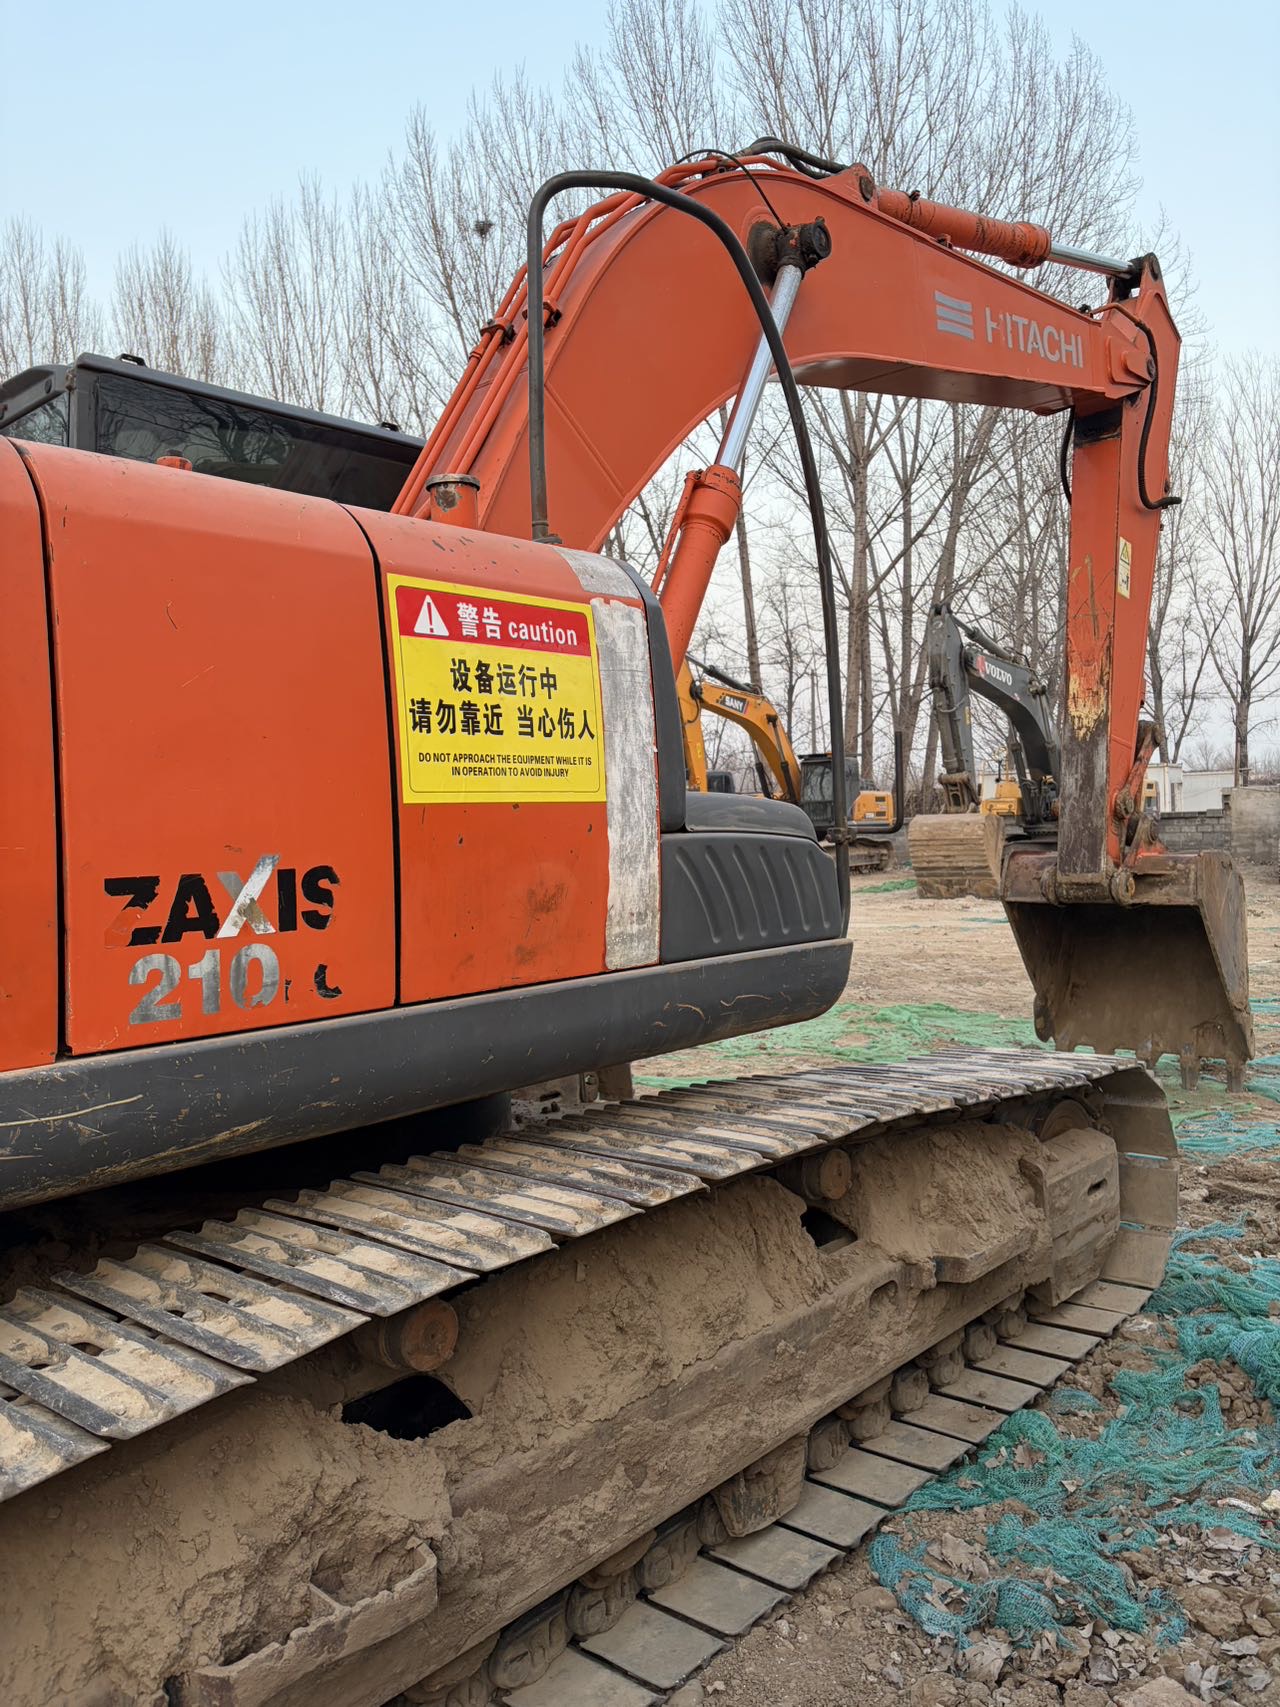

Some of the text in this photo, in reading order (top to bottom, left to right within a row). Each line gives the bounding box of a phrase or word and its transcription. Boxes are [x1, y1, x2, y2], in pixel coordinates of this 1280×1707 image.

[985, 307, 1083, 368] HITACHI
[456, 602, 578, 646] 警告 caution
[450, 658, 558, 700] 设备运行中
[985, 661, 1012, 686] VOLVO
[409, 698, 596, 740] 请勿靠近 当心伤人
[418, 752, 592, 766] DO NOT APPROACH THE EQUIPMENT WHILE IT IS
[451, 766, 569, 777] IN OPERATION TO AVOID INJURY
[104, 855, 341, 948] ZAXIS
[128, 943, 280, 1025] 210
